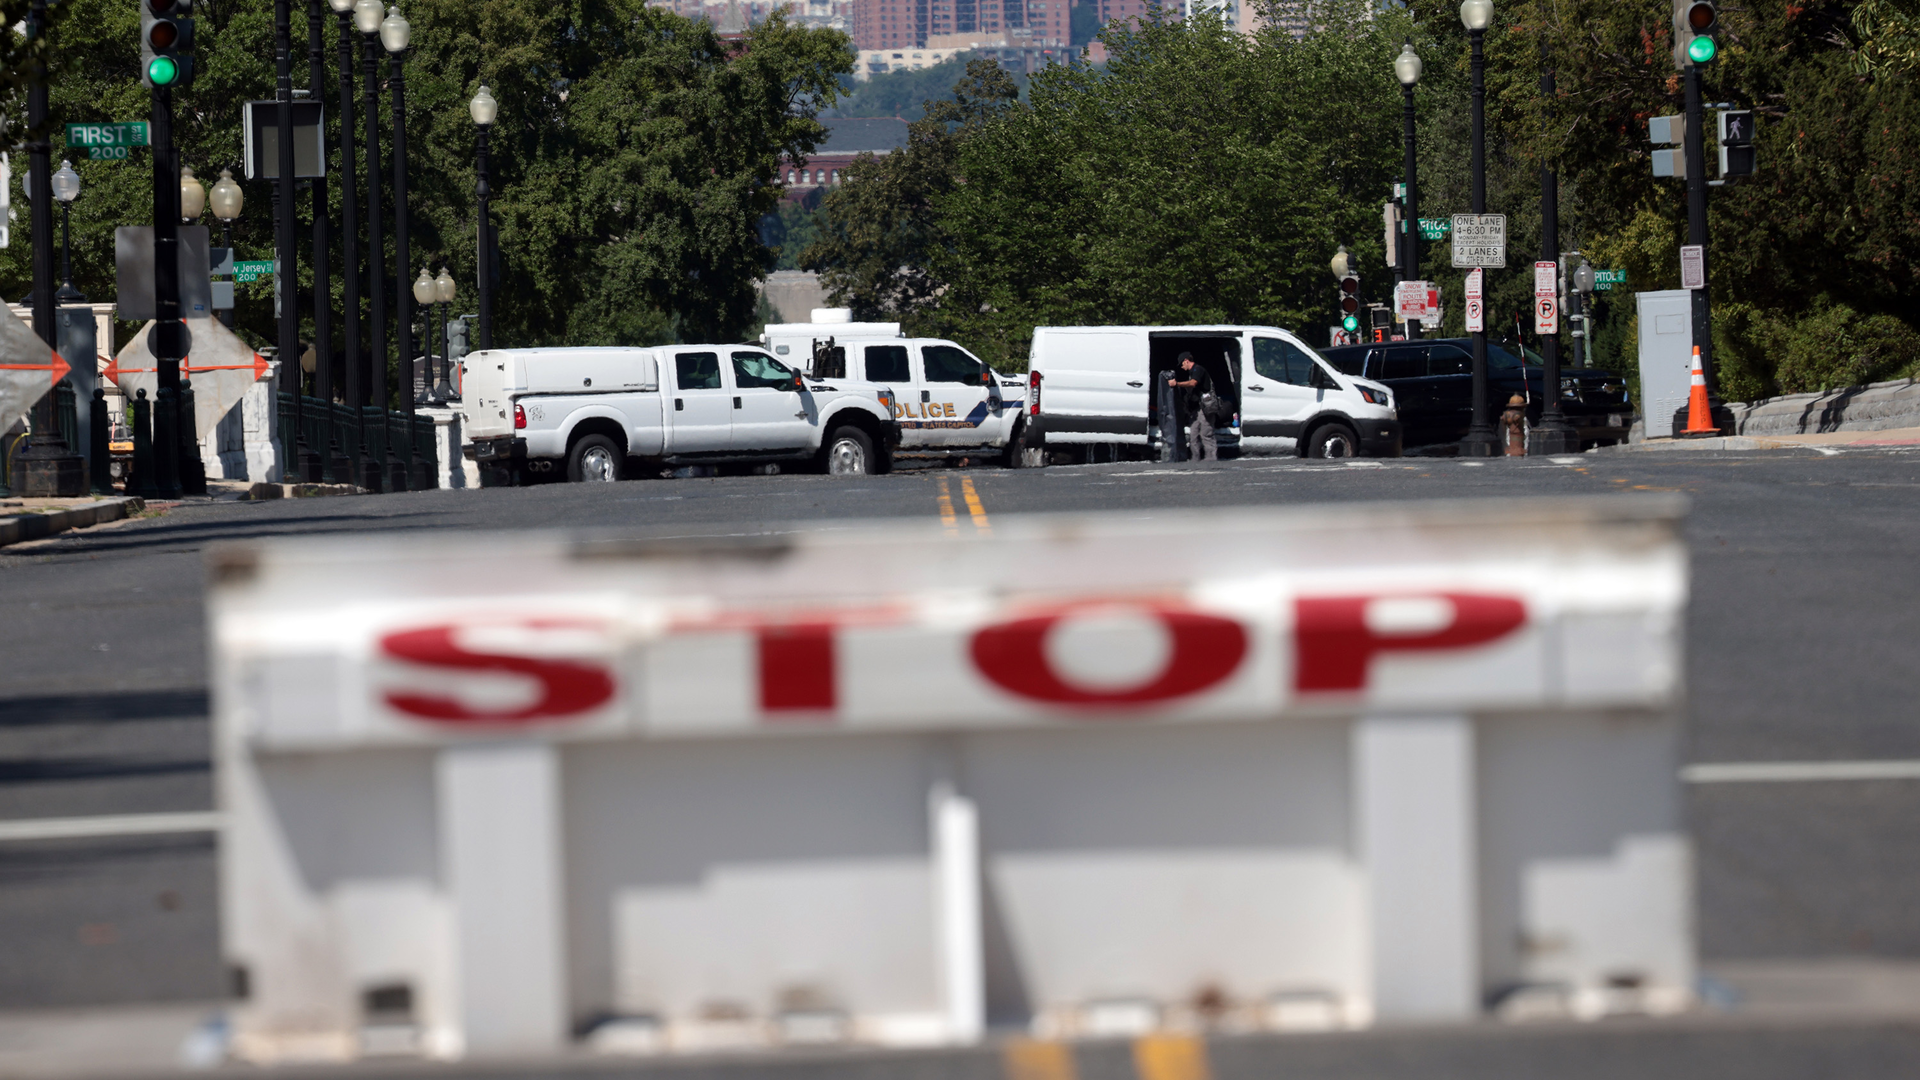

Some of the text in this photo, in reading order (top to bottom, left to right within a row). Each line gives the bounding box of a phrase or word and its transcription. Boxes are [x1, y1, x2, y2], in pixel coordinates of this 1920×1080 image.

[71, 125, 142, 144] FIRST ST
[131, 134, 142, 142] SE
[91, 146, 126, 159] 200
[1457, 216, 1501, 226] ONE LANE
[1422, 231, 1442, 240] 100
[1457, 226, 1501, 235] 4-6:30 PM
[1459, 247, 1498, 256] 2 LANES
[1466, 256, 1485, 264] OTHER
[1486, 256, 1502, 265] TIMES
[241, 264, 267, 274] Jersey
[238, 273, 256, 281] 200
[1594, 271, 1616, 282] PITOL
[895, 402, 957, 418] OLICE
[378, 592, 1530, 724] STOP
